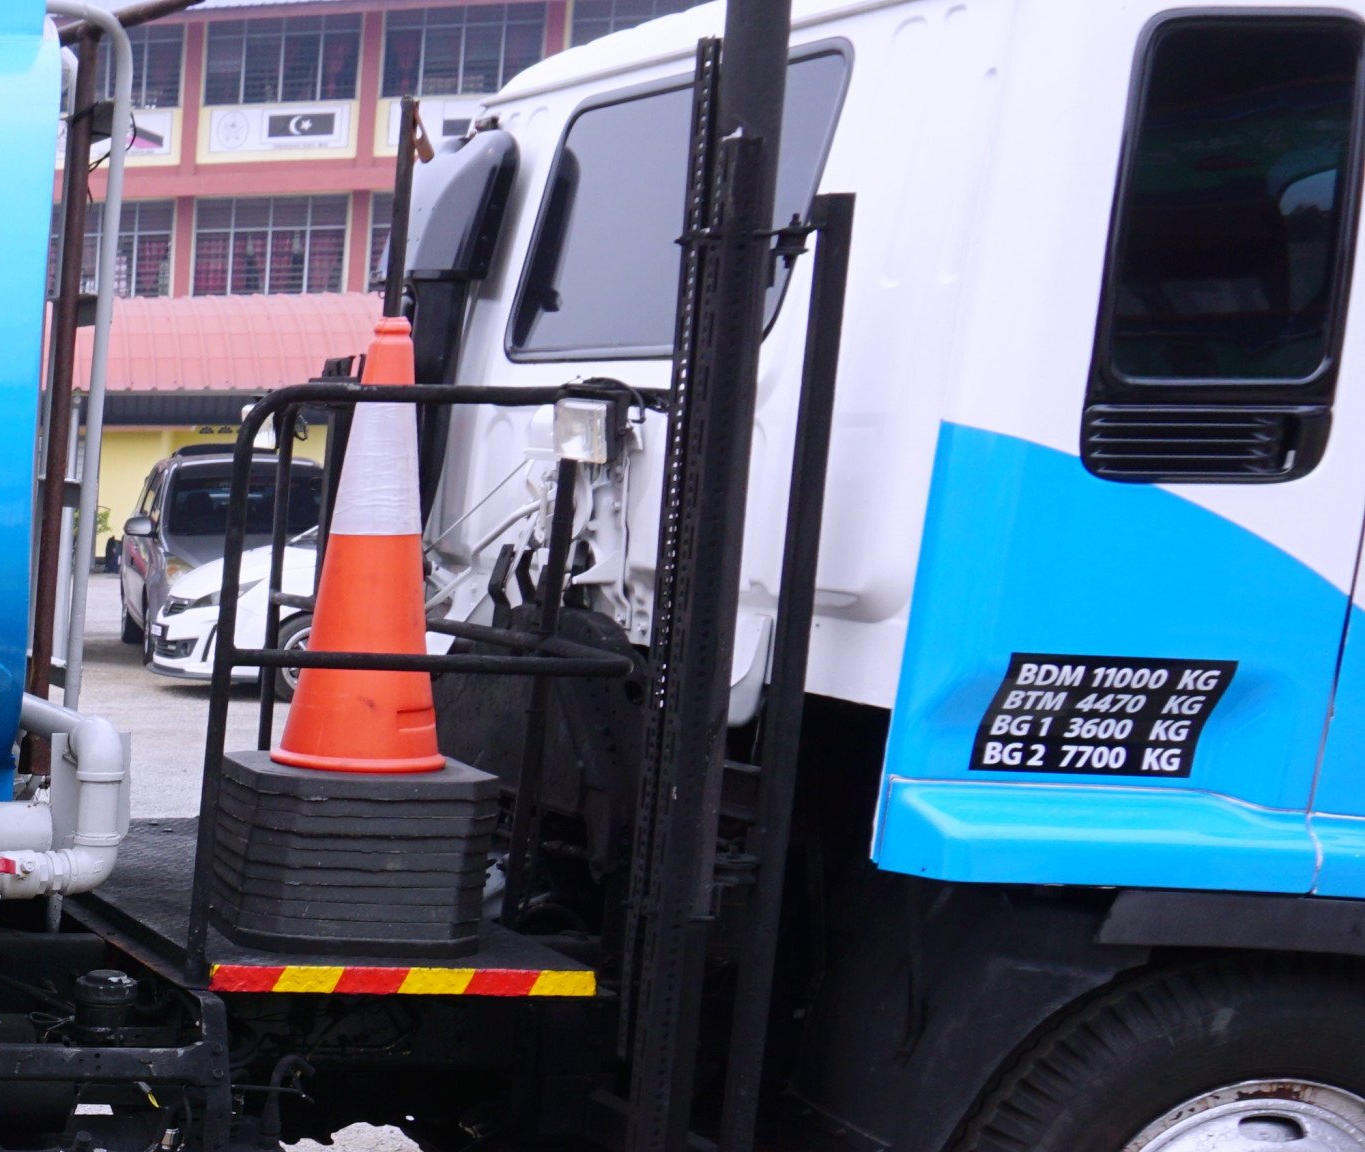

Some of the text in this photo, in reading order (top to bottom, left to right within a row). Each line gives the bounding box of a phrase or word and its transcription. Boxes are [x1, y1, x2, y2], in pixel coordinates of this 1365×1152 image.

[1016, 663, 1221, 691] BDM 11000 KG
[1002, 690, 1206, 715] BTM 4470 KG
[990, 714, 1192, 741] BG 1 3600 KG
[982, 742, 1181, 771] BG 2 7700 KG
